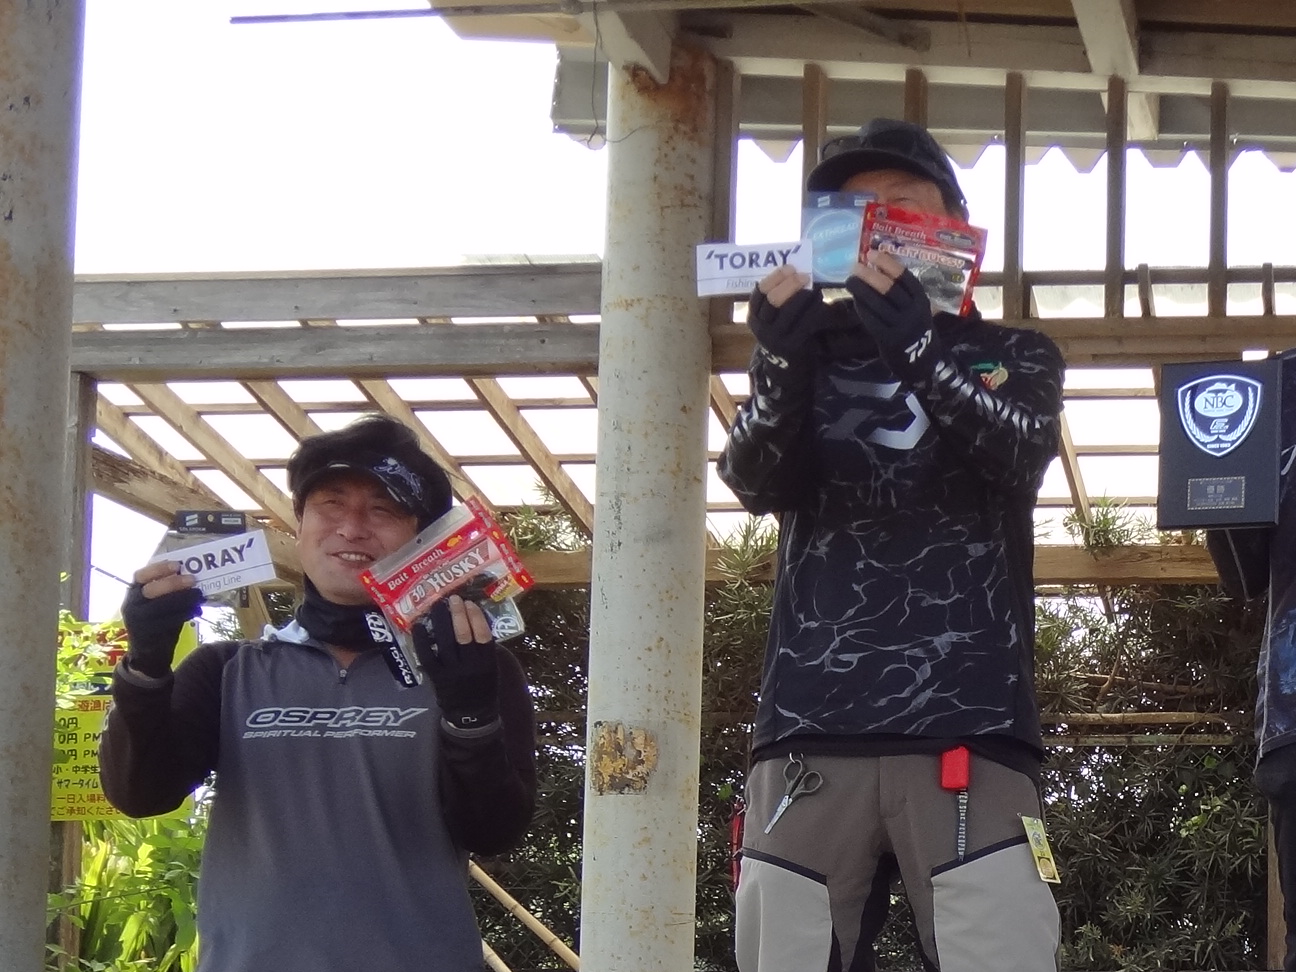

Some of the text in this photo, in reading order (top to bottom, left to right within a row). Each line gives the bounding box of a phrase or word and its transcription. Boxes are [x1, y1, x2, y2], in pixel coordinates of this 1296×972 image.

[1203, 395, 1235, 410] NBC
[387, 571, 410, 592] Bait
[411, 548, 445, 575] Breath
[426, 547, 489, 594] HUSKY
[222, 573, 242, 586] Line
[246, 707, 429, 728] OSPREY
[242, 729, 417, 739] SPIRITUAL PERFORMER
